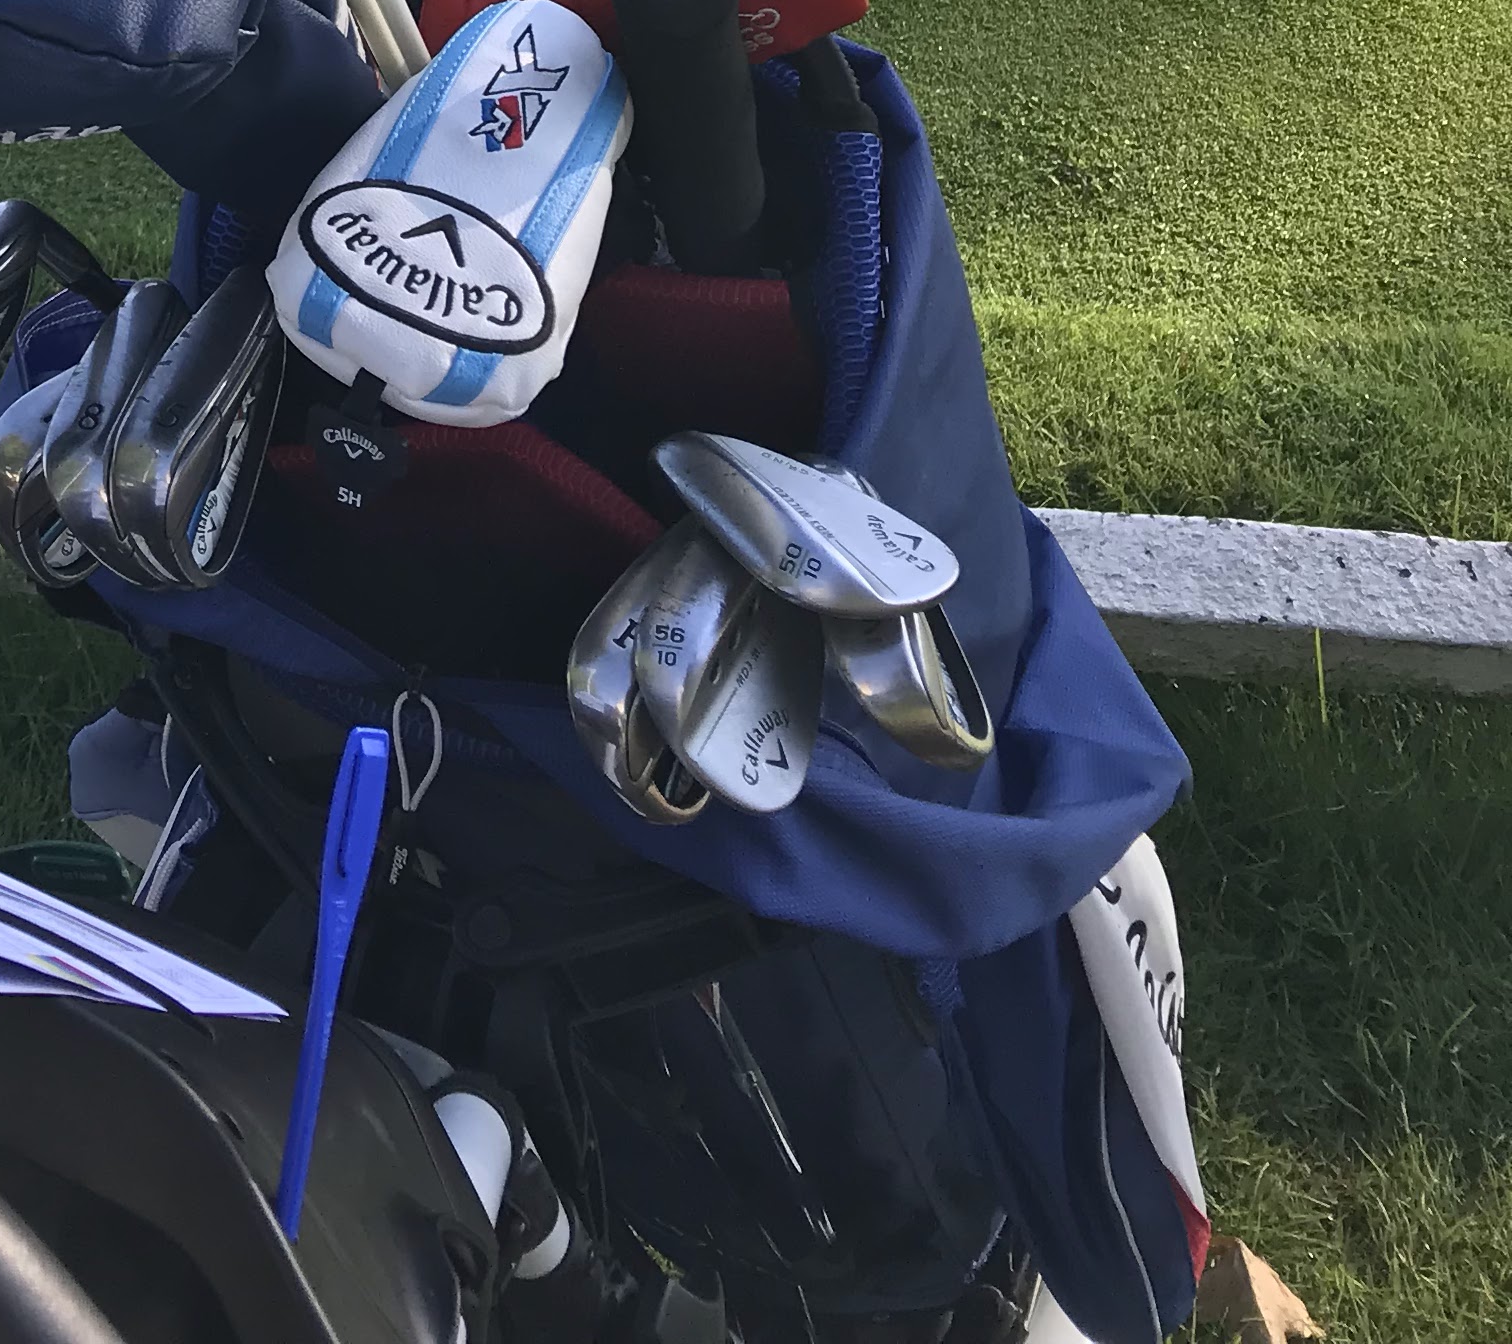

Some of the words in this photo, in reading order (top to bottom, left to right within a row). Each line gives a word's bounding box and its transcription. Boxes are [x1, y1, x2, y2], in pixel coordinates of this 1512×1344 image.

[329, 211, 523, 326] Callaway
[78, 402, 105, 431] 8
[323, 426, 386, 461] Callaway
[337, 486, 362, 508] 5H
[197, 494, 218, 555] Callaway
[778, 543, 802, 575] 50
[867, 513, 936, 574] Callaway
[803, 557, 822, 580] 10
[654, 623, 685, 644] 56
[656, 650, 678, 667] 10
[742, 707, 789, 787] Callaway
